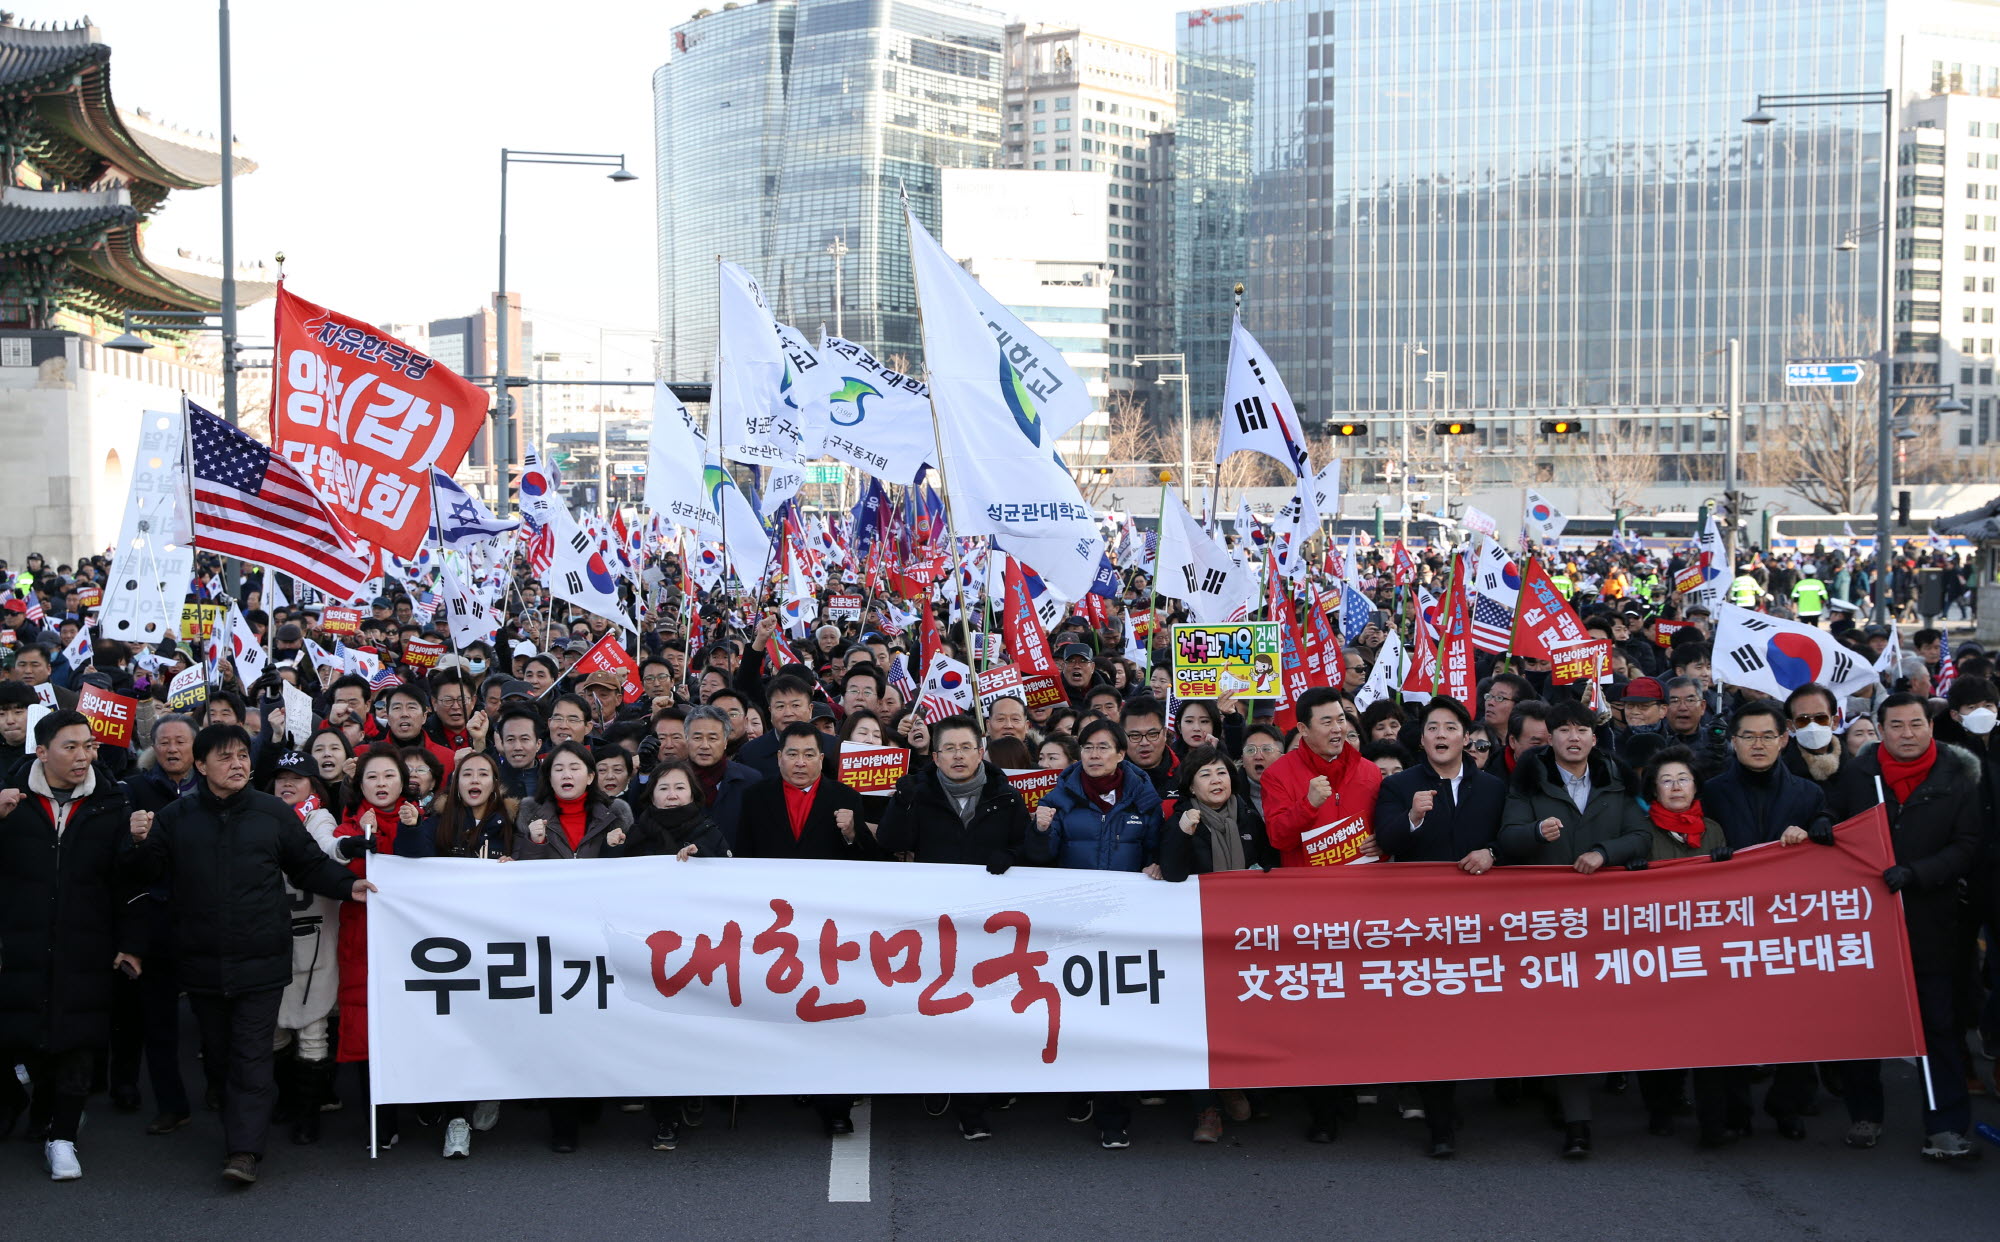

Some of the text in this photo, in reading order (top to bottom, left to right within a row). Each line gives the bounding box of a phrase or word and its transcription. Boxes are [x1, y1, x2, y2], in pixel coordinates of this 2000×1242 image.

[318, 321, 435, 381] 자유한국당
[834, 405, 854, 418] 1398
[986, 502, 1089, 523] 성균관대학교
[830, 597, 860, 608] 친문농단
[1529, 578, 1563, 615] 文정권
[324, 620, 357, 632] 공범이다
[326, 610, 358, 622] 청와대도
[1022, 620, 1050, 672] 국정농단
[1178, 627, 1252, 664] 천국과지옥
[1257, 626, 1278, 653] 검색
[1323, 638, 1342, 687] 국정농단
[1553, 643, 1608, 664] 밀실야합예산
[1177, 668, 1217, 682] 인터넷
[1449, 639, 1469, 703] 국정농단
[1179, 682, 1216, 695] 유튜브
[82, 692, 128, 720] 청와대도
[842, 753, 904, 770] 밀실야합예산
[842, 767, 904, 788] 국민심판
[1306, 816, 1365, 855] 밀실야합예산
[1235, 925, 1280, 951] 2대
[1603, 896, 1755, 936] 비례대표제
[1767, 886, 1873, 925] 선거법)
[405, 936, 615, 1015] 우리가
[1237, 931, 1876, 1001] 文정권 국정농단 3대 게이트 규탄대회
